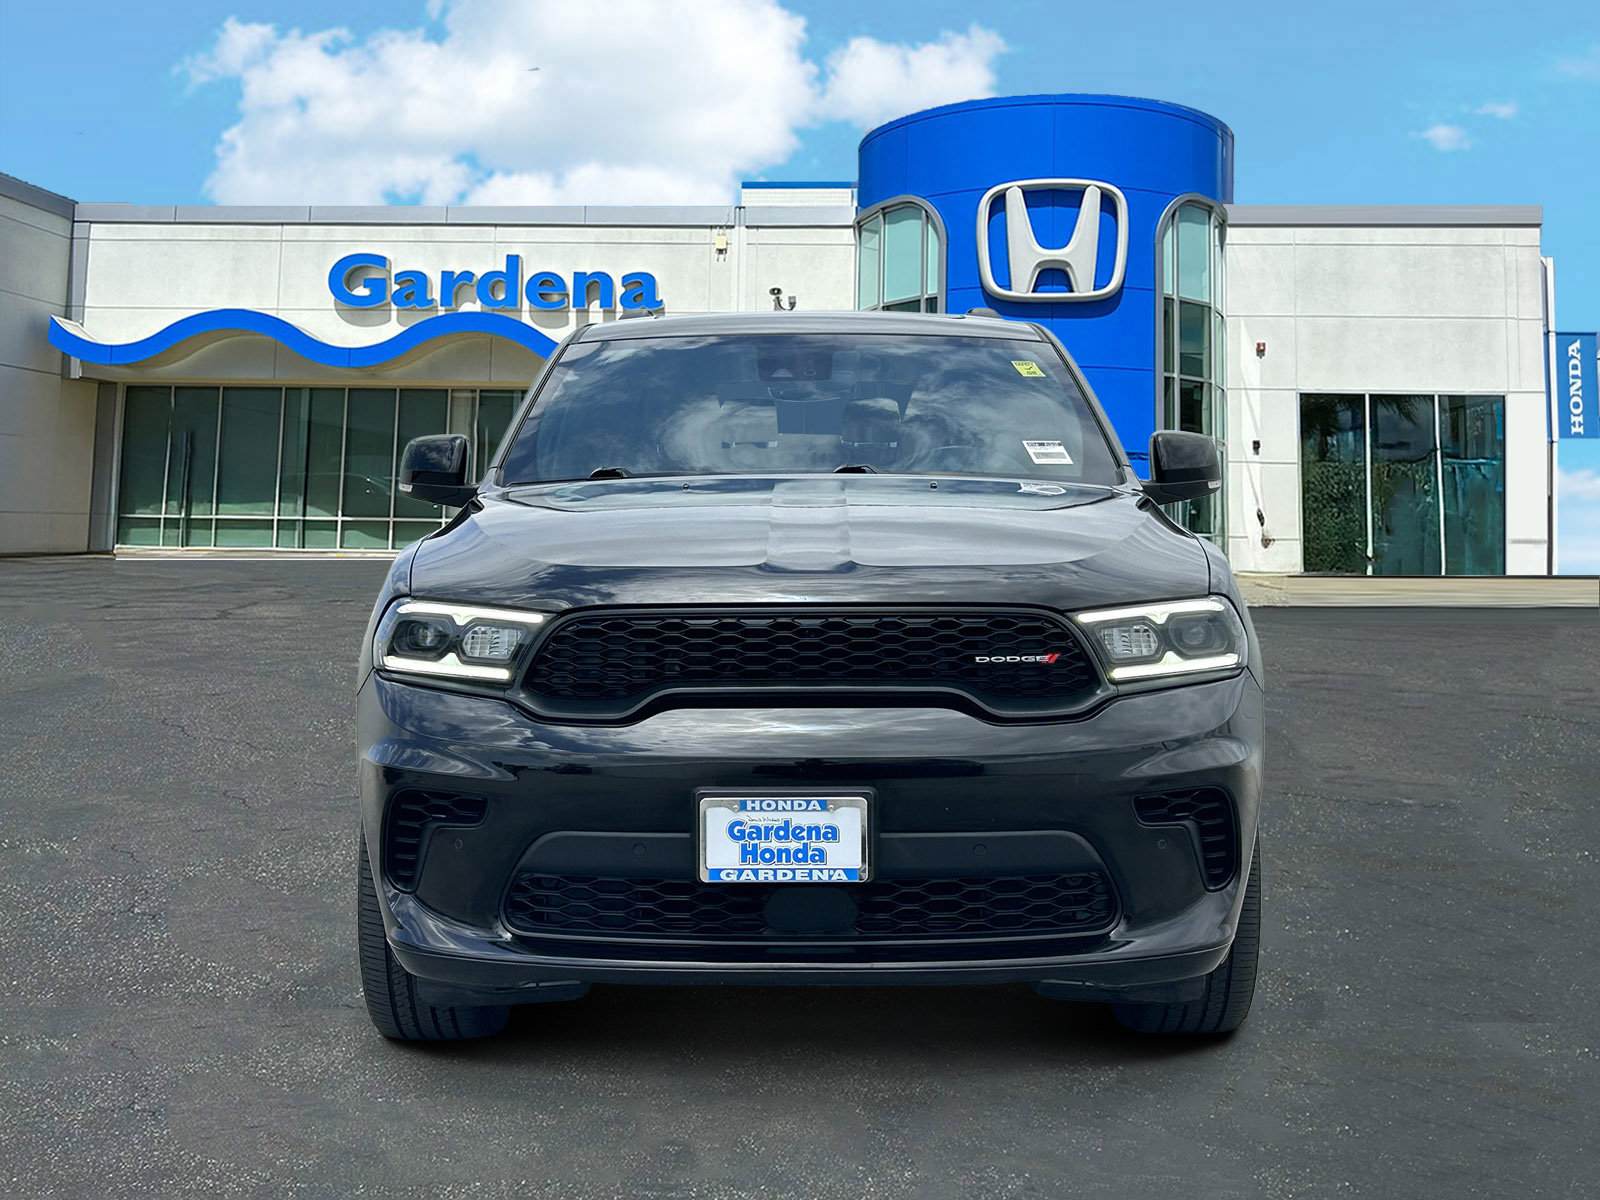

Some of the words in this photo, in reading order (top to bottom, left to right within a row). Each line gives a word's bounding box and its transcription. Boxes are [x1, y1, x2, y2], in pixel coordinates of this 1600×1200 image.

[328, 252, 664, 310] Gardena
[1568, 338, 1585, 436] HONDA
[975, 655, 1049, 664] DODGE
[745, 799, 823, 812] HONDA
[727, 819, 838, 842] Gardena
[740, 842, 826, 864] Honda
[719, 869, 849, 881] GARDENA
